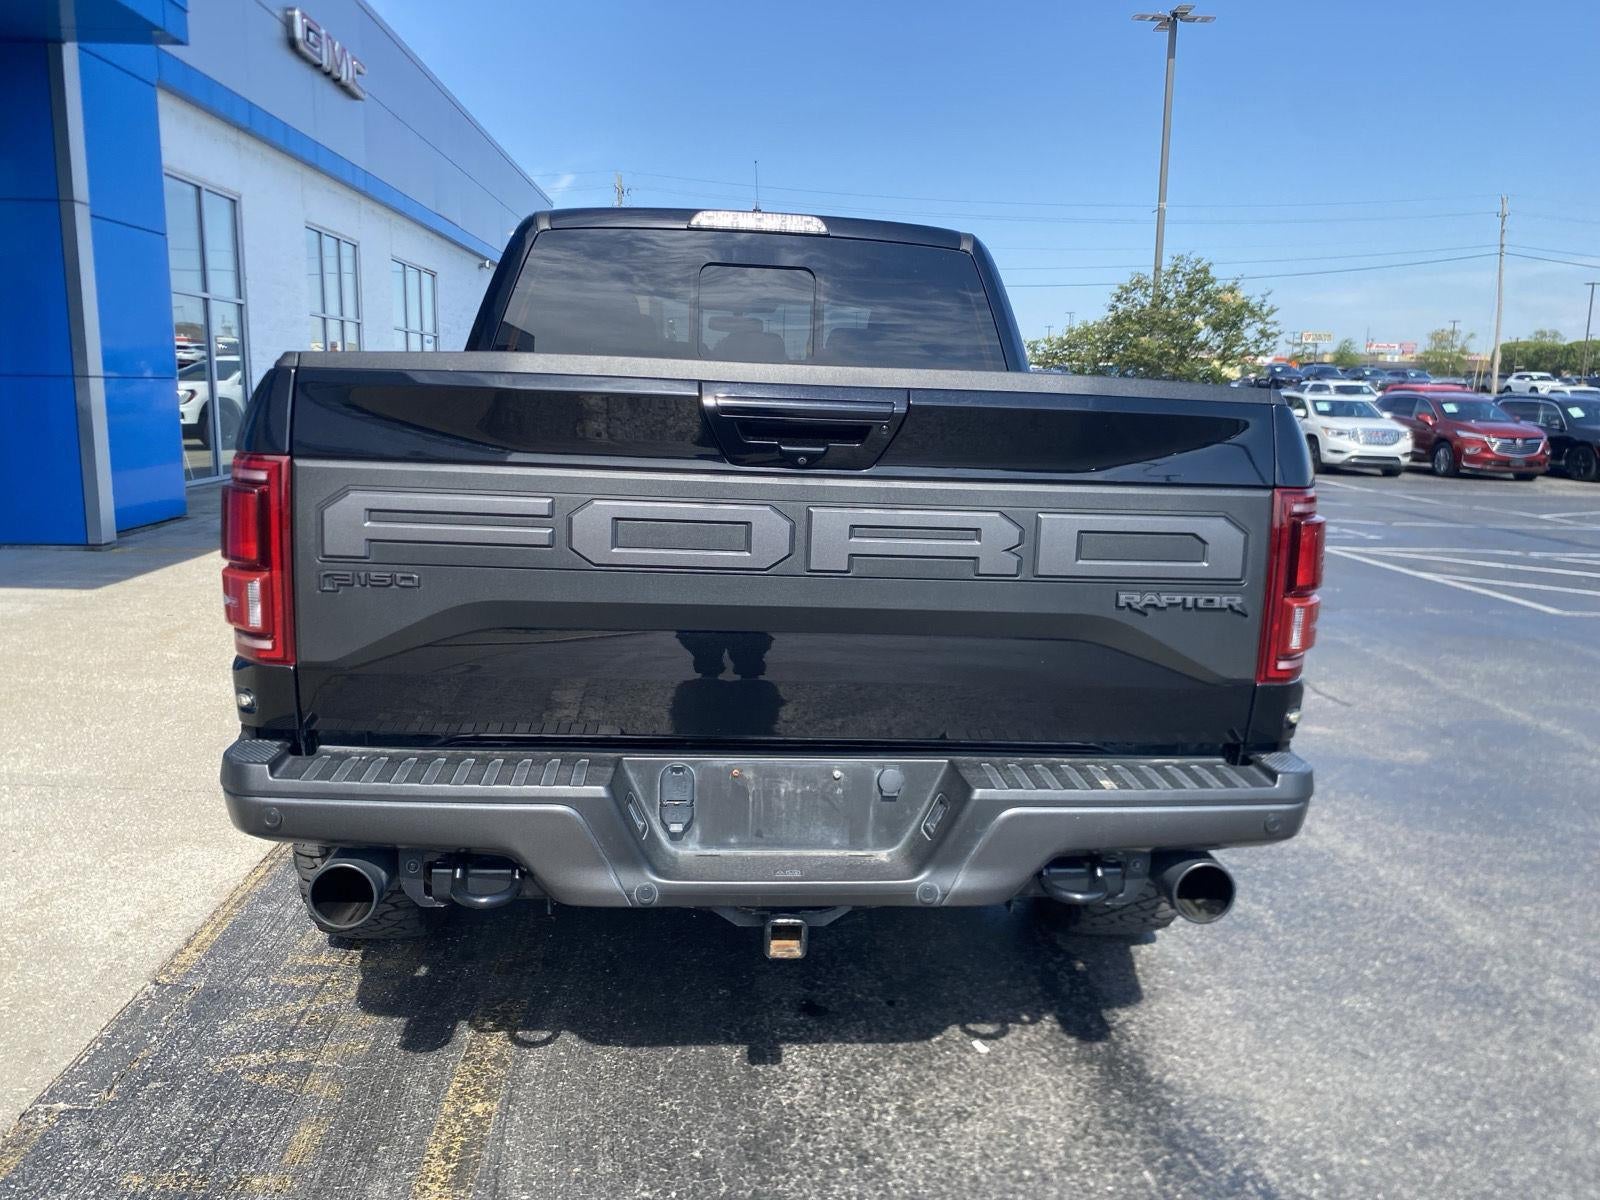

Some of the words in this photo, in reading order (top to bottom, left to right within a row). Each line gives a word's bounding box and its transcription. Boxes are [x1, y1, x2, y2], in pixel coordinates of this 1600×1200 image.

[284, 7, 367, 101] GMC
[320, 489, 1248, 581] FORD
[319, 572, 420, 592] F150
[1116, 591, 1248, 617] RAPTOR
